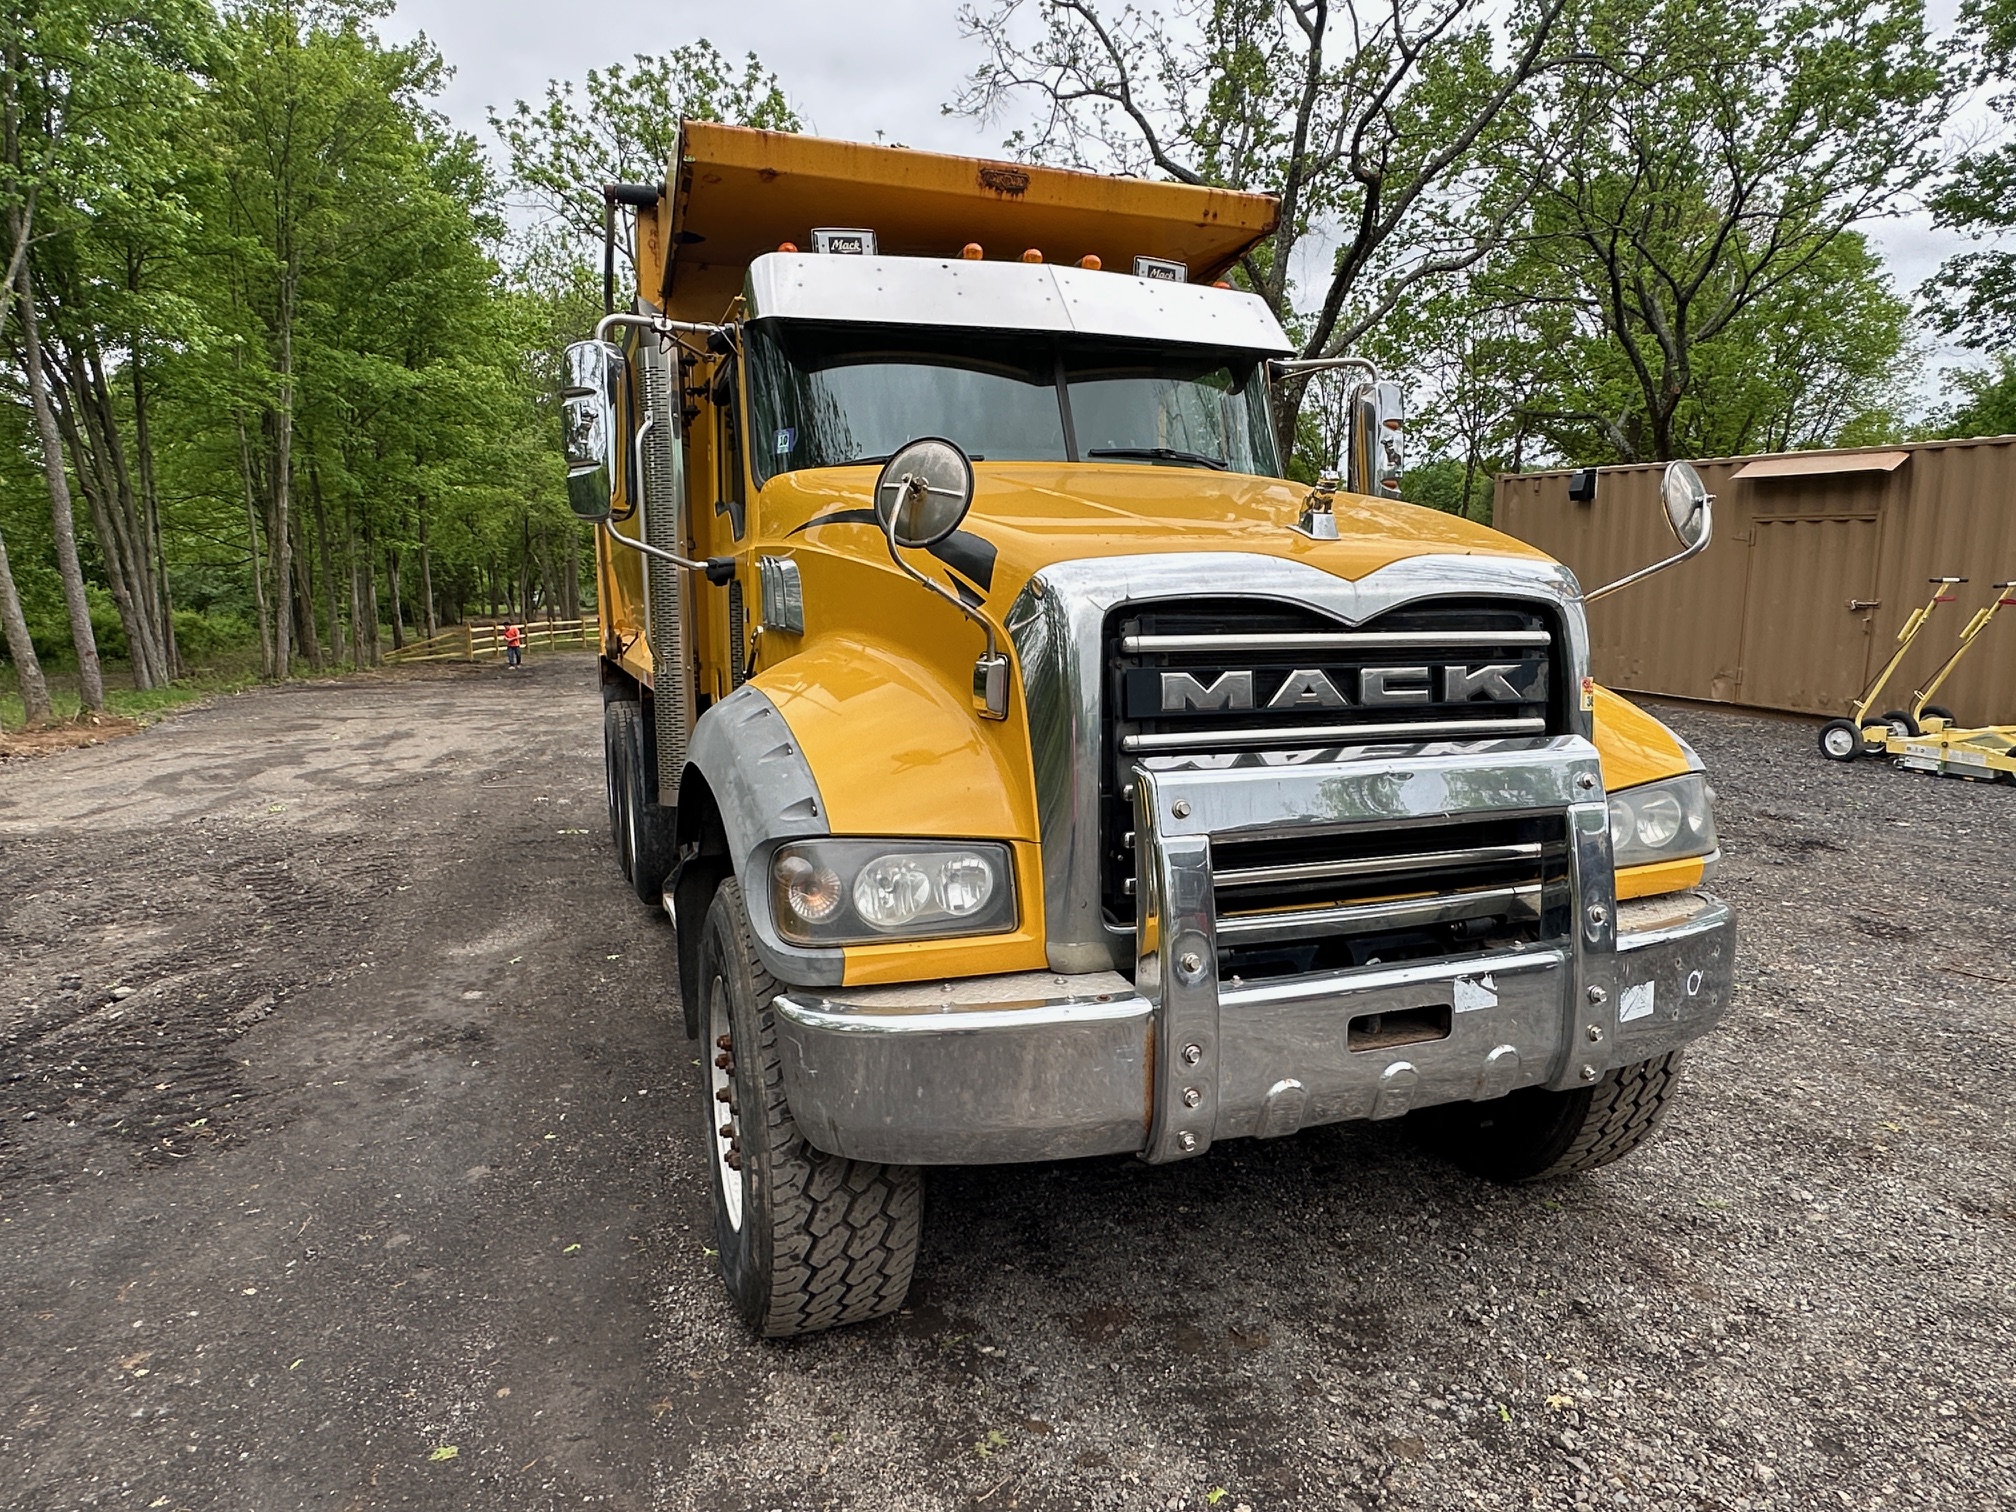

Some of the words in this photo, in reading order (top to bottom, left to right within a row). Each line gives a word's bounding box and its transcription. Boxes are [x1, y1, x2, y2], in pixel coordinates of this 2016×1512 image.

[830, 239, 862, 251] Mack
[1149, 268, 1175, 281] Mack
[1160, 664, 1522, 711] MACK
